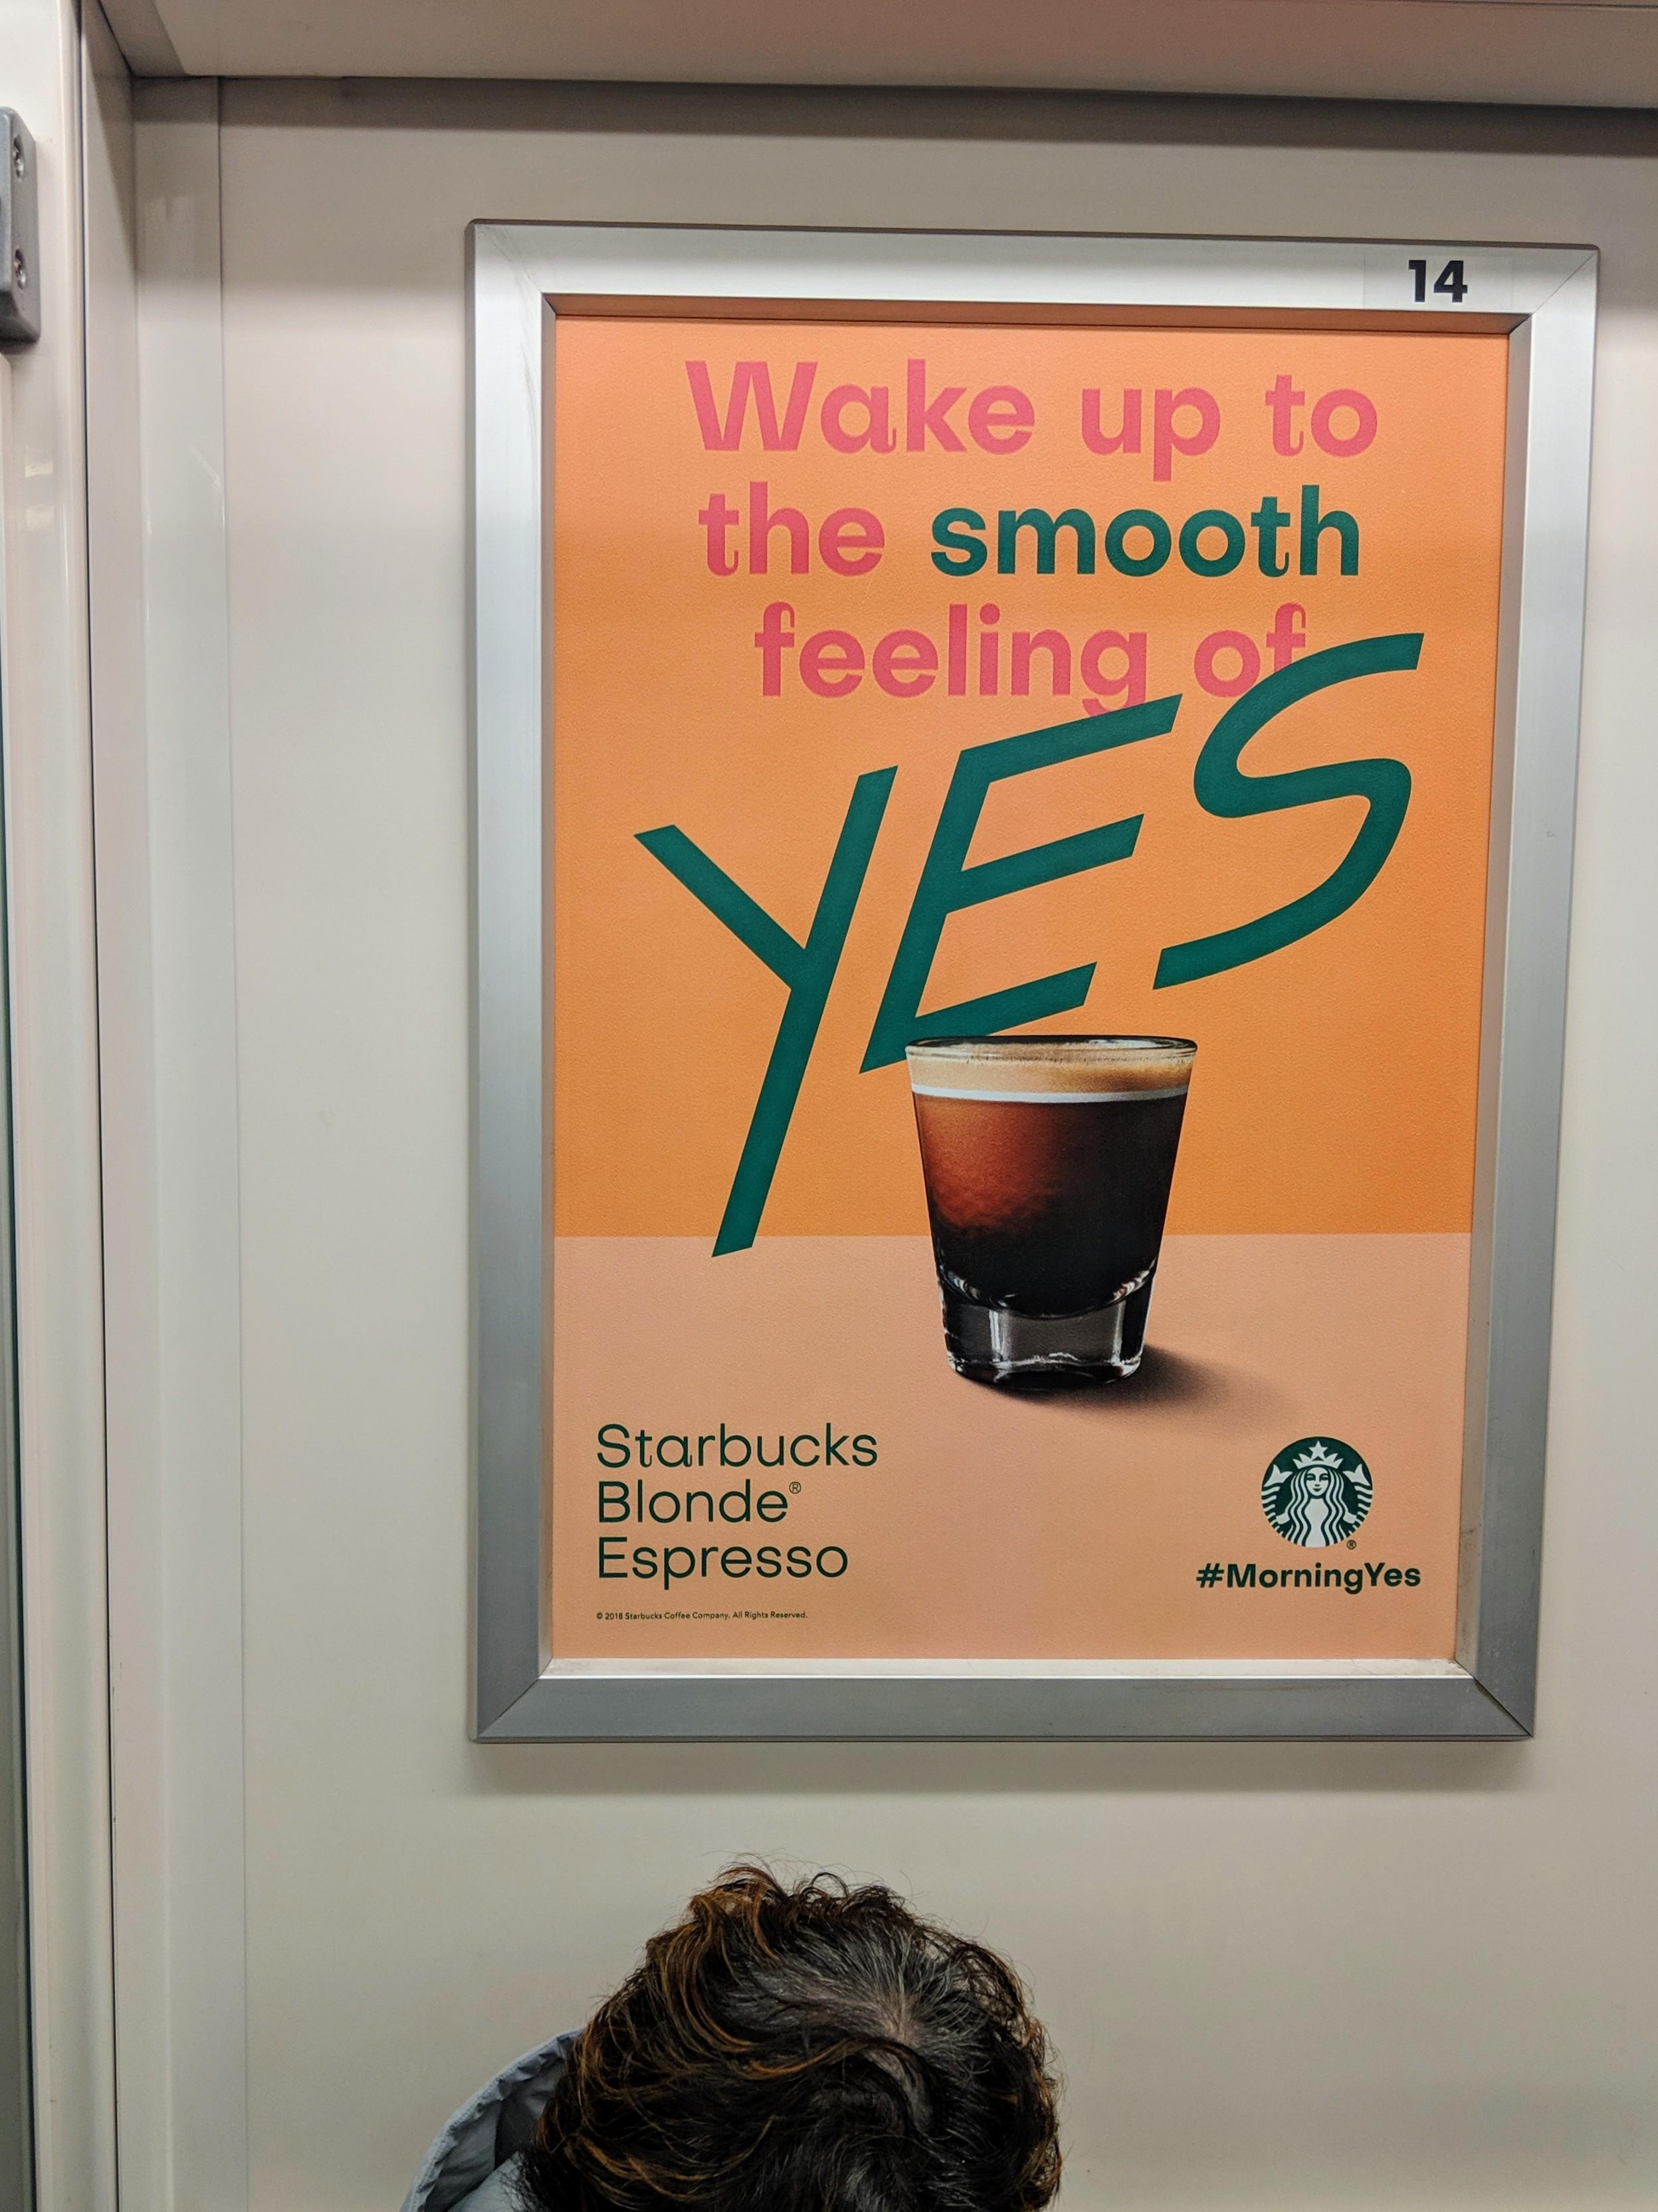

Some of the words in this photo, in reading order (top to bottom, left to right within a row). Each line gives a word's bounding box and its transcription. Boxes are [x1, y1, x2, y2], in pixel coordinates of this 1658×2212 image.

[1408, 260, 1467, 303] 14
[685, 359, 1035, 454] Wake
[1081, 383, 1221, 482] up
[1266, 374, 1378, 458] to
[698, 482, 885, 577] the
[931, 484, 1359, 578] smooth
[754, 601, 1147, 718] feeling
[1193, 601, 1306, 699] of
[633, 633, 1424, 1257] YES
[597, 1423, 878, 1468] Starbucks
[598, 1536, 849, 1590] Espresso
[1196, 1562, 1421, 1595] #MorningYes
[692, 1611, 731, 1621] Company.
[744, 1611, 768, 1621] Rights
